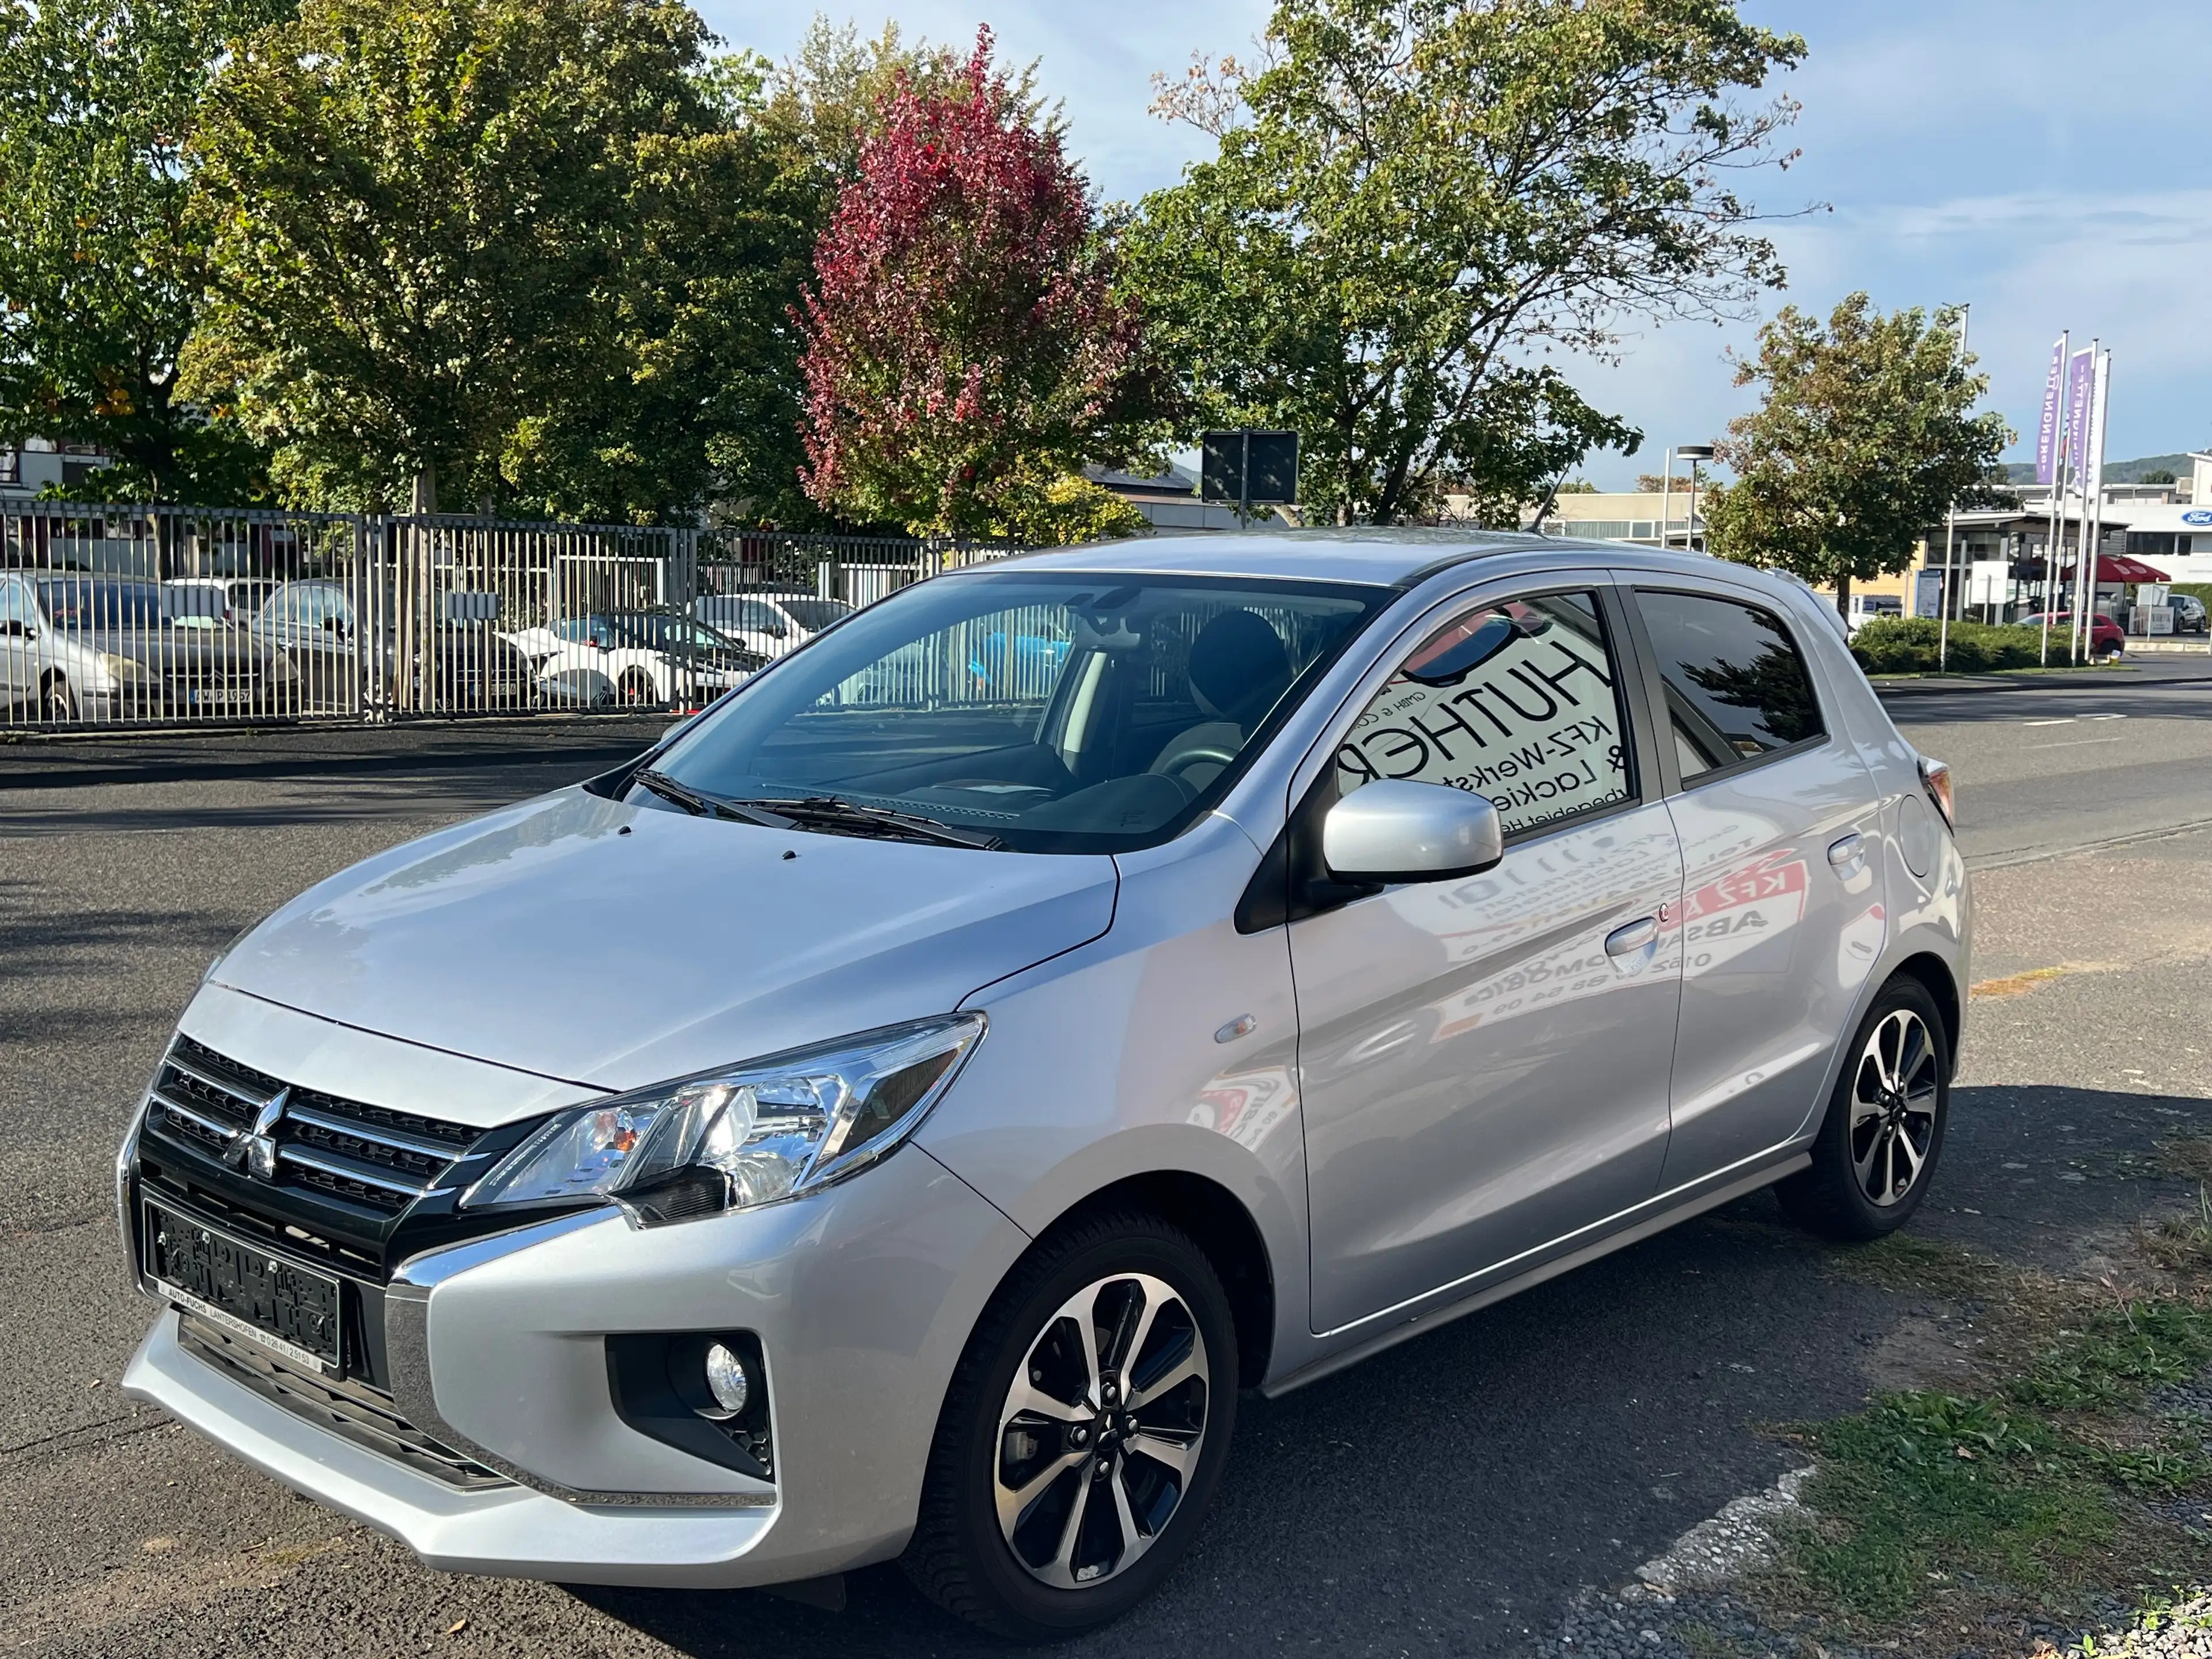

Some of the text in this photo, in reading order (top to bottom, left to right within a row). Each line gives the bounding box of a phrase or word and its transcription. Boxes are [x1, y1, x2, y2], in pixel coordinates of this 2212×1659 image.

[2187, 512, 2211, 522] Ford
[217, 691, 224, 702] P
[169, 1288, 207, 1314] AUTO-FUCHS
[210, 1307, 257, 1339] LANTERSHOFEN
